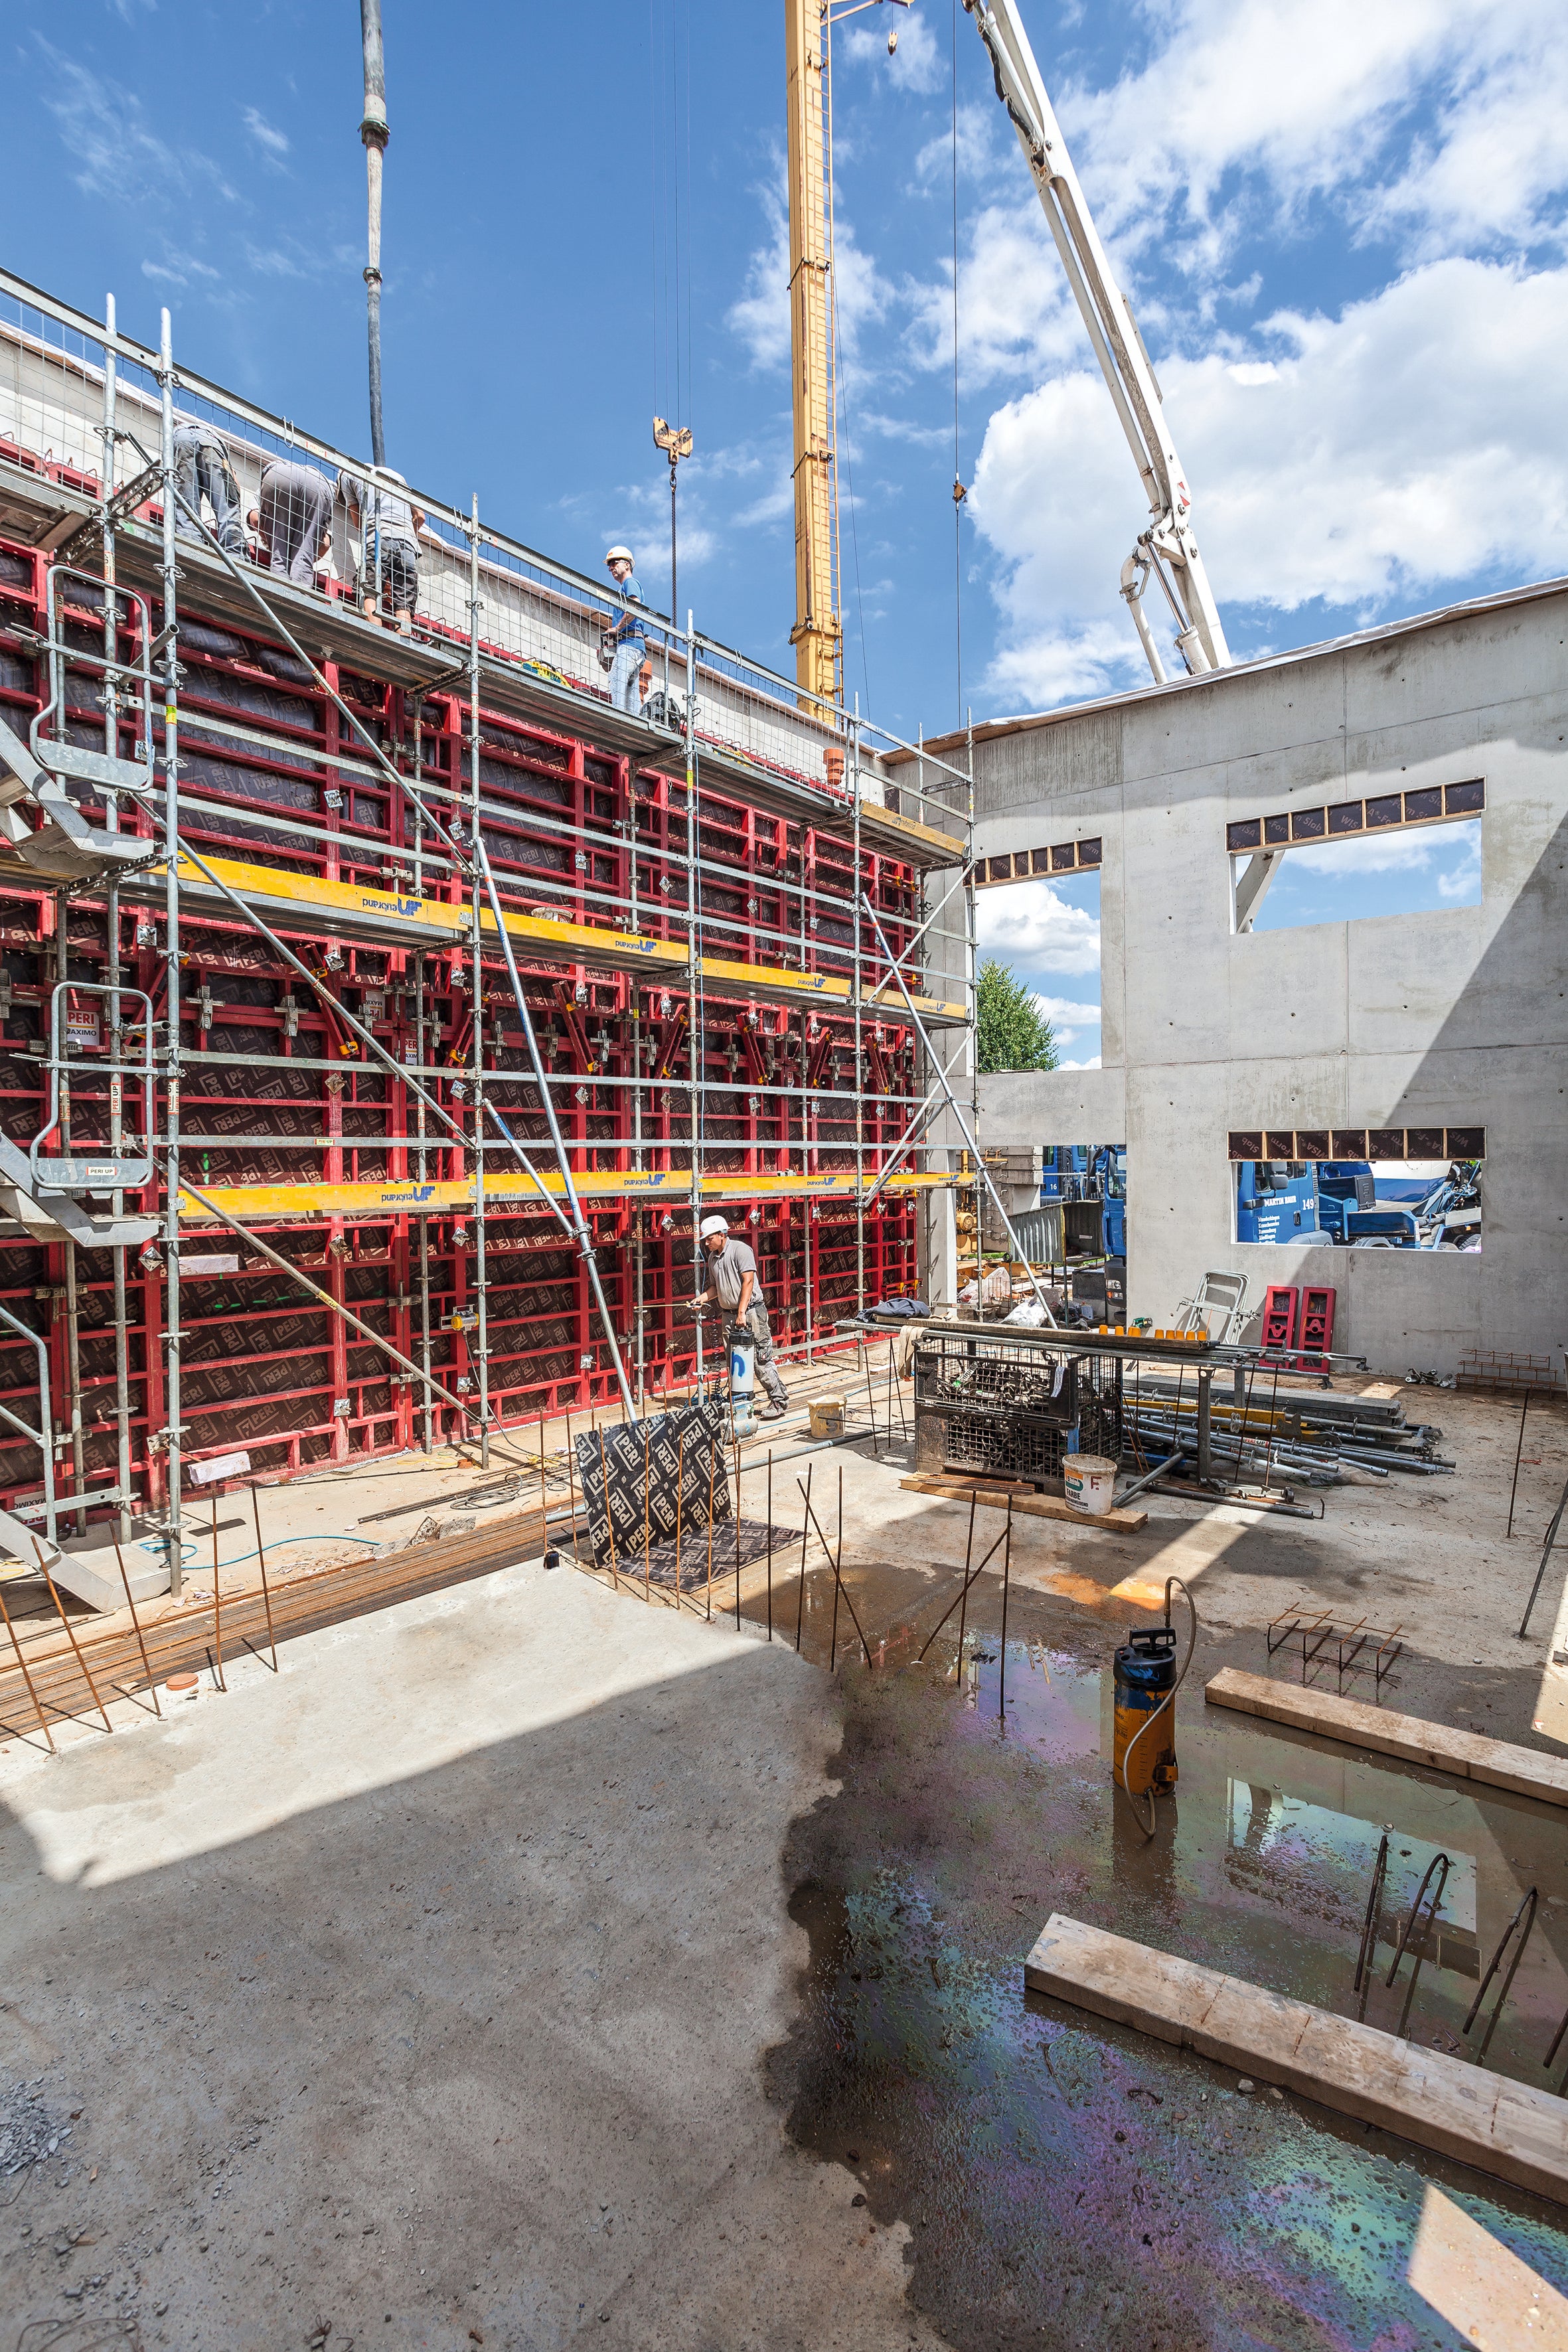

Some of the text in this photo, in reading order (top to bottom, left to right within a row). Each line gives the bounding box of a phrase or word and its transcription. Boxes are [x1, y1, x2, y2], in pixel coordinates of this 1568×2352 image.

[57, 595, 63, 605] UP
[206, 815, 222, 832] ERI
[522, 849, 539, 863] PERI
[68, 1012, 95, 1024] PERI
[406, 1040, 417, 1049] PER
[113, 1085, 119, 1096] UP
[206, 1077, 224, 1097] PER
[278, 1107, 297, 1135] PERI
[1241, 1137, 1260, 1154] Slab
[1302, 1199, 1314, 1210] 149
[277, 1317, 300, 1336] PERI
[255, 1333, 273, 1353] PER
[211, 1370, 232, 1395] PERI
[264, 1368, 288, 1386] PERI
[304, 1366, 328, 1386] PERI
[253, 1403, 276, 1424] PERI
[702, 1401, 719, 1427] PER
[682, 1425, 702, 1452] PERI
[618, 1435, 641, 1466] PERI
[655, 1443, 676, 1473] PERI
[589, 1457, 615, 1487] PERI
[713, 1488, 730, 1510] ERI
[1067, 1488, 1081, 1500] FARBE
[608, 1492, 631, 1524] PERI
[657, 1496, 677, 1527] PERI
[591, 1523, 609, 1549] PER
